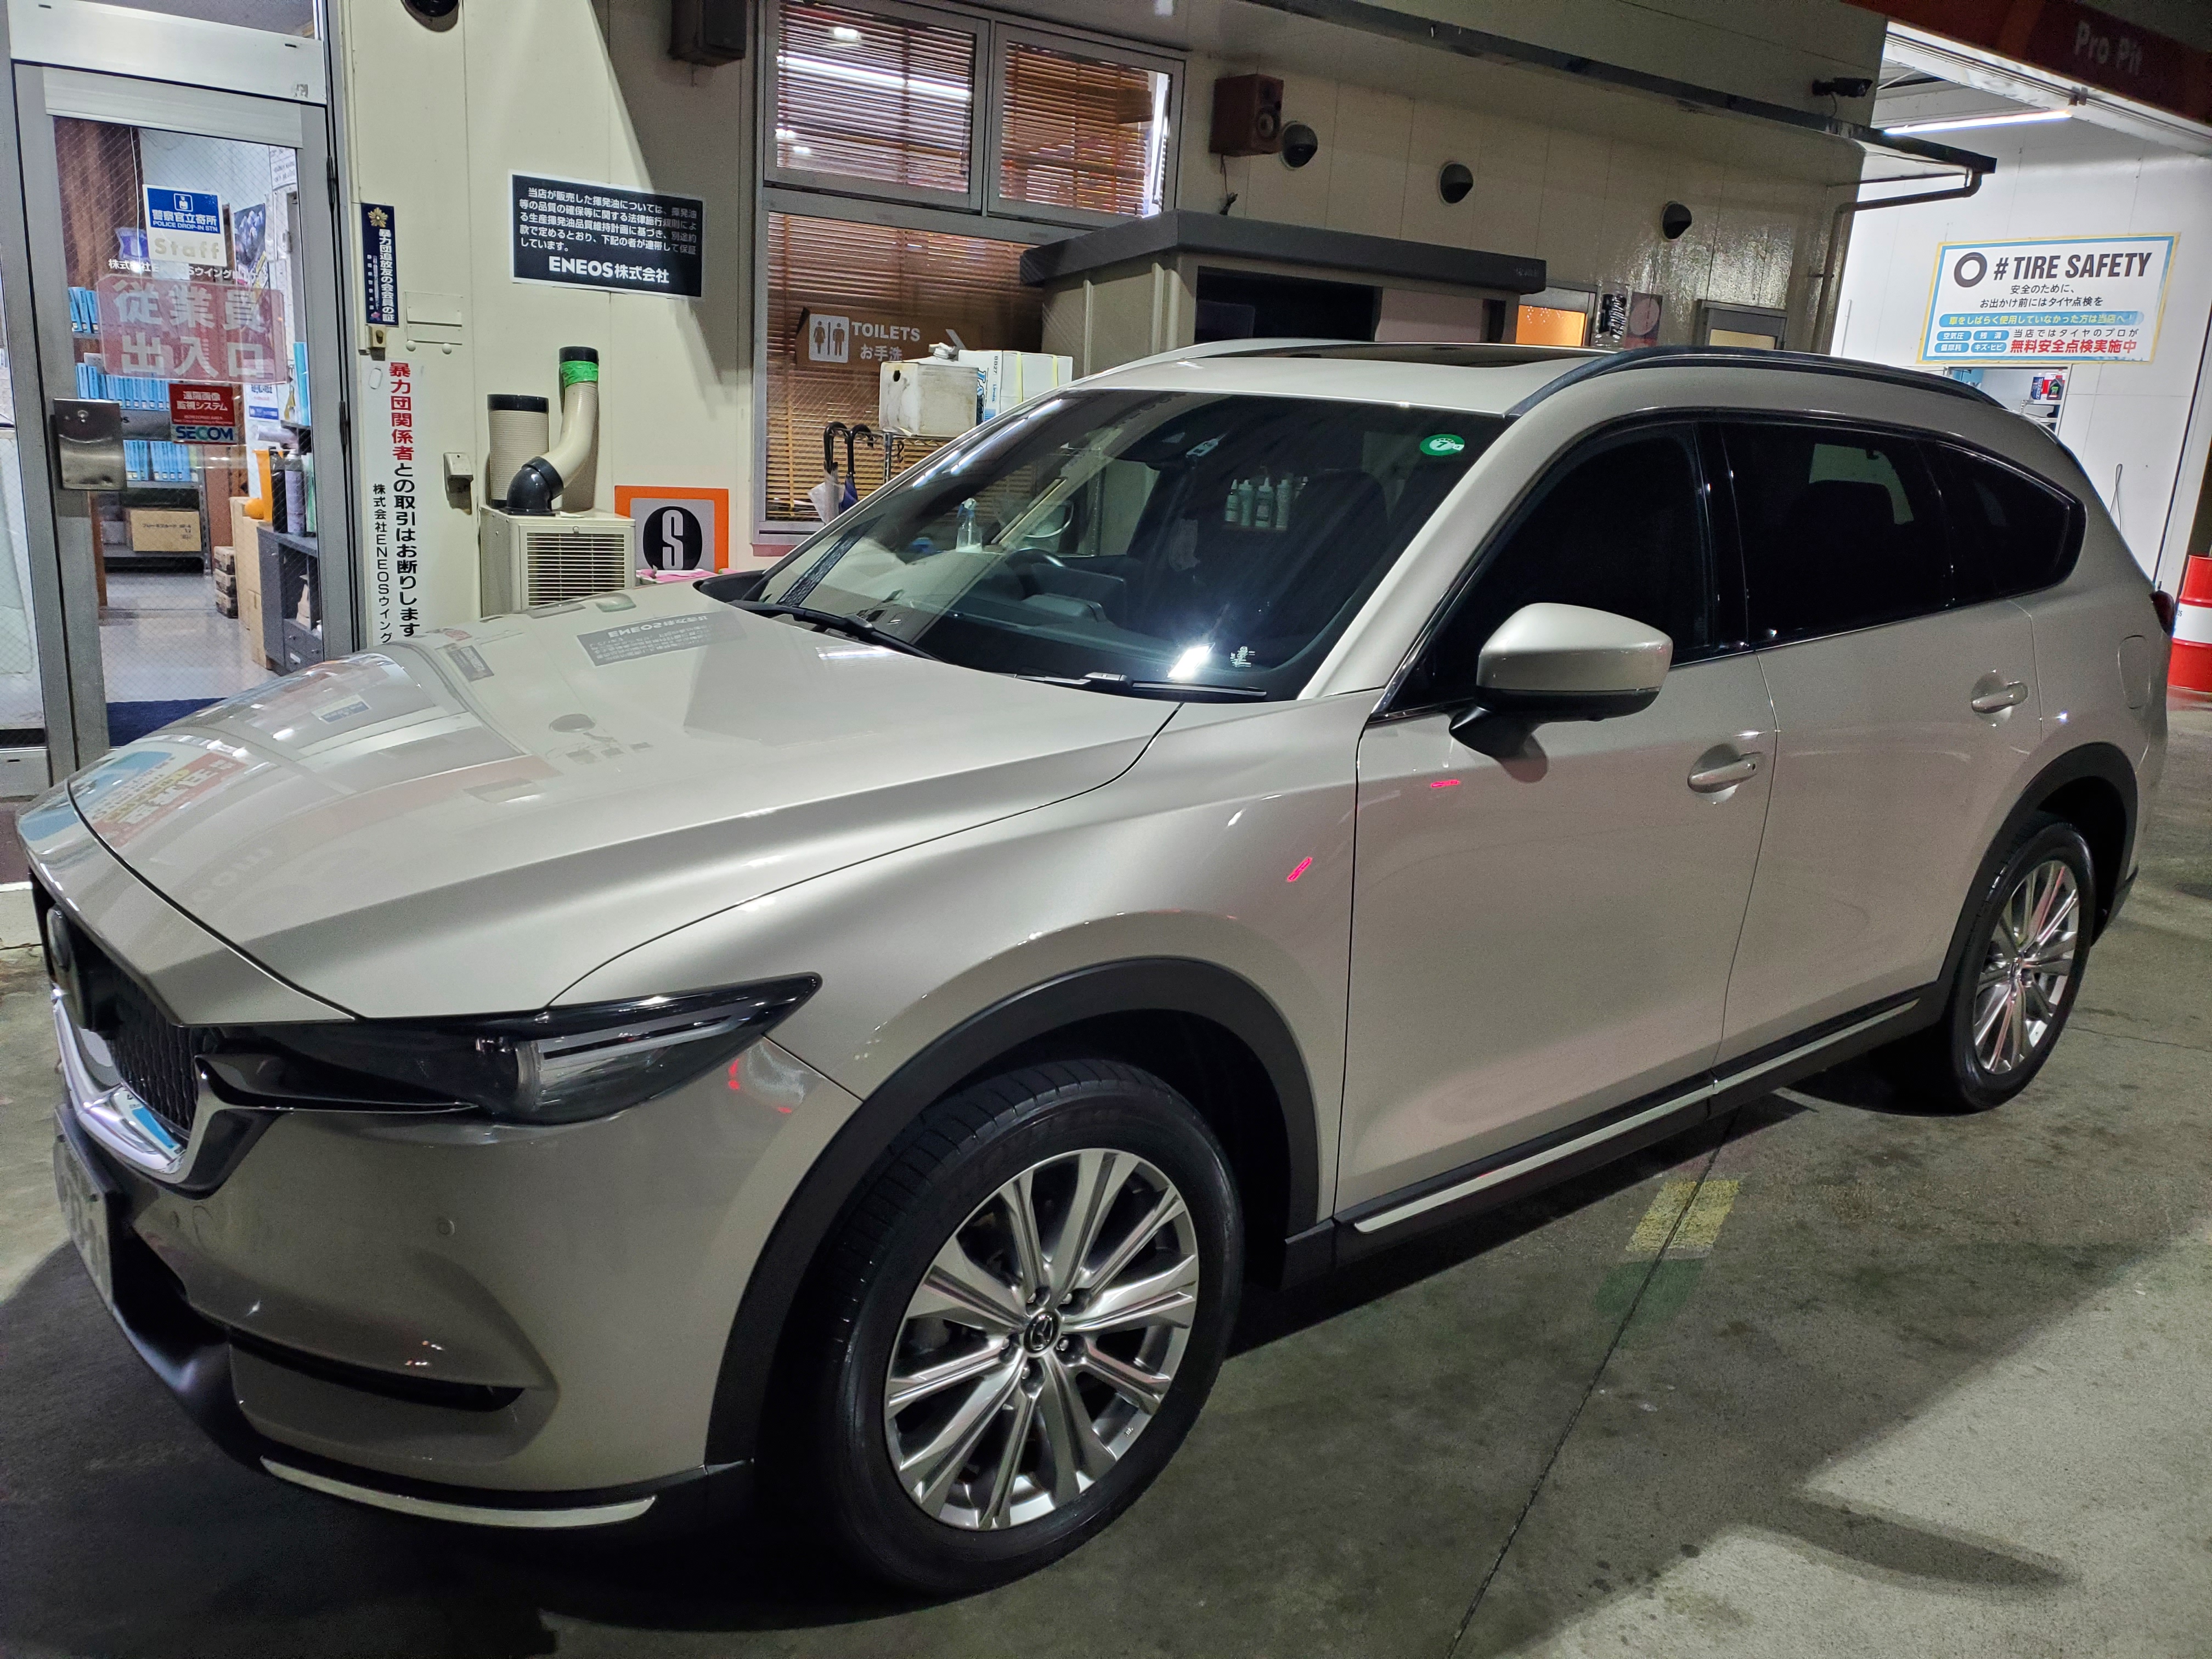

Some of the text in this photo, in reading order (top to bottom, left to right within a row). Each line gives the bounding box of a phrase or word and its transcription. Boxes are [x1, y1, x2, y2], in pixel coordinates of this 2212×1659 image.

[2075, 20, 2109, 64] Pro
[528, 187, 697, 219] 当店が販売した揮発油については、揮発油
[151, 209, 217, 226] 警察官立寄所
[519, 199, 697, 231] 等の品質の確保等に関する法律施行規則によ
[177, 223, 205, 231] DROP-IN
[520, 211, 696, 243] る生産揮発油品質維持計画に基づき、別途約
[154, 238, 219, 259] Staff
[519, 224, 696, 255] 款で定めるとおり、下記の者が連帯して保証
[521, 237, 569, 252] しています。
[2013, 255, 2061, 280] TIRE
[2064, 252, 2153, 279] SAFETY
[2010, 283, 2076, 295] 安全のために、
[112, 279, 270, 334] 従業員
[1979, 296, 2104, 308] お出かけ前にはタイヤ点検を
[851, 321, 921, 342] TOILETS
[1943, 332, 1965, 341] 空気圧
[2013, 328, 2139, 338] 当店ではタイヤのプロが
[121, 331, 265, 379] 出入口
[2010, 340, 2137, 354] 無料安全点検実施中
[175, 425, 234, 441] SECOM
[388, 362, 420, 637] 暴力団関係者との取引はお断りします
[373, 483, 393, 645] 株式会社ENEOSウイング
